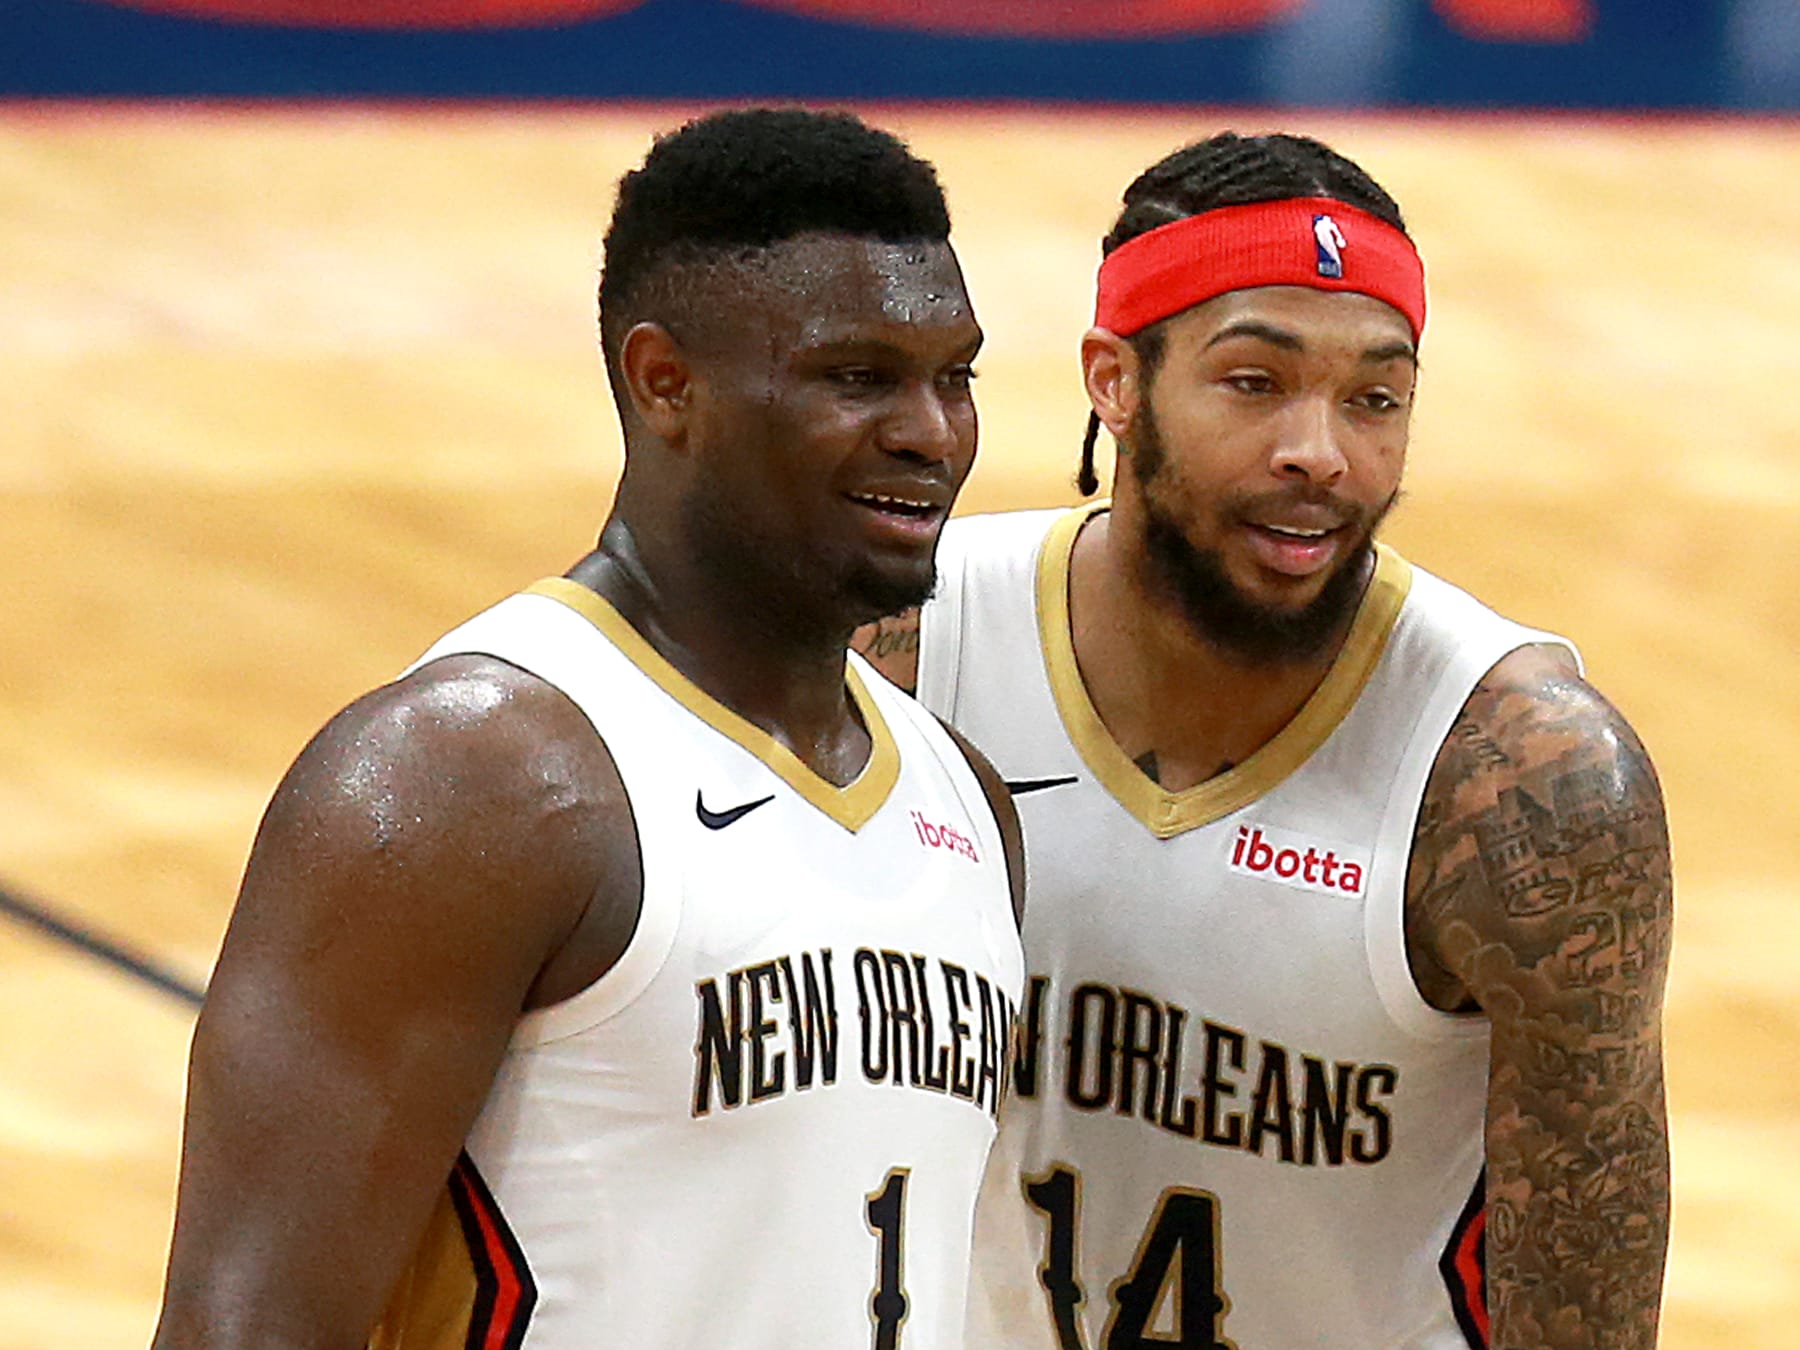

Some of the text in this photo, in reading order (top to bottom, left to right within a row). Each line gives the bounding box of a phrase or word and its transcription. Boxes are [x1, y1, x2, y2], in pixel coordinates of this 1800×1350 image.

[910, 810, 979, 863] ibotta
[1231, 825, 1362, 893] ibotta
[692, 948, 838, 1118] NEW
[1066, 982, 1399, 1167] ORLEANS
